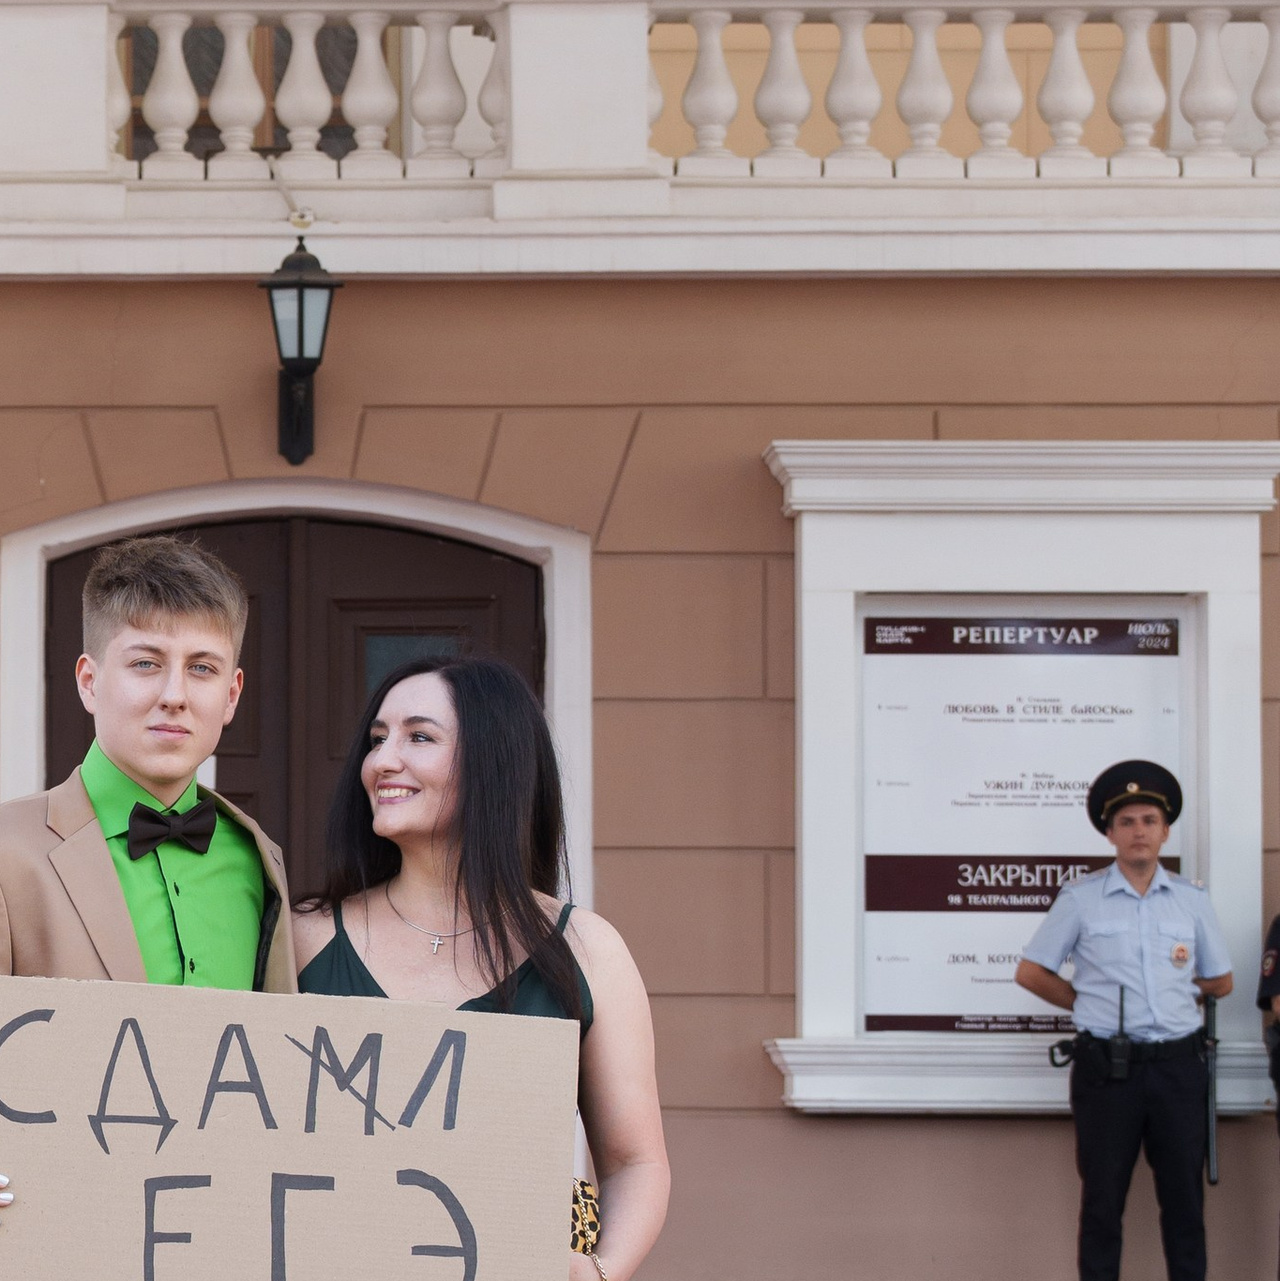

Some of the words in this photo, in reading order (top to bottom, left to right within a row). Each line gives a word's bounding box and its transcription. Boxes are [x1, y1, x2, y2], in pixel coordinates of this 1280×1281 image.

[1126, 622, 1171, 636] ИЮЛЬ
[952, 626, 1100, 645] РЕПЕРТУАР
[1137, 636, 1170, 649] 2024
[942, 704, 1000, 715] ЛЮБОВЬ
[1022, 704, 1064, 715] СТИЛЕ
[984, 780, 1024, 790] УЖИН
[947, 894, 962, 906] 98
[967, 894, 1051, 906] ТЕАТРАЛЬНОГО
